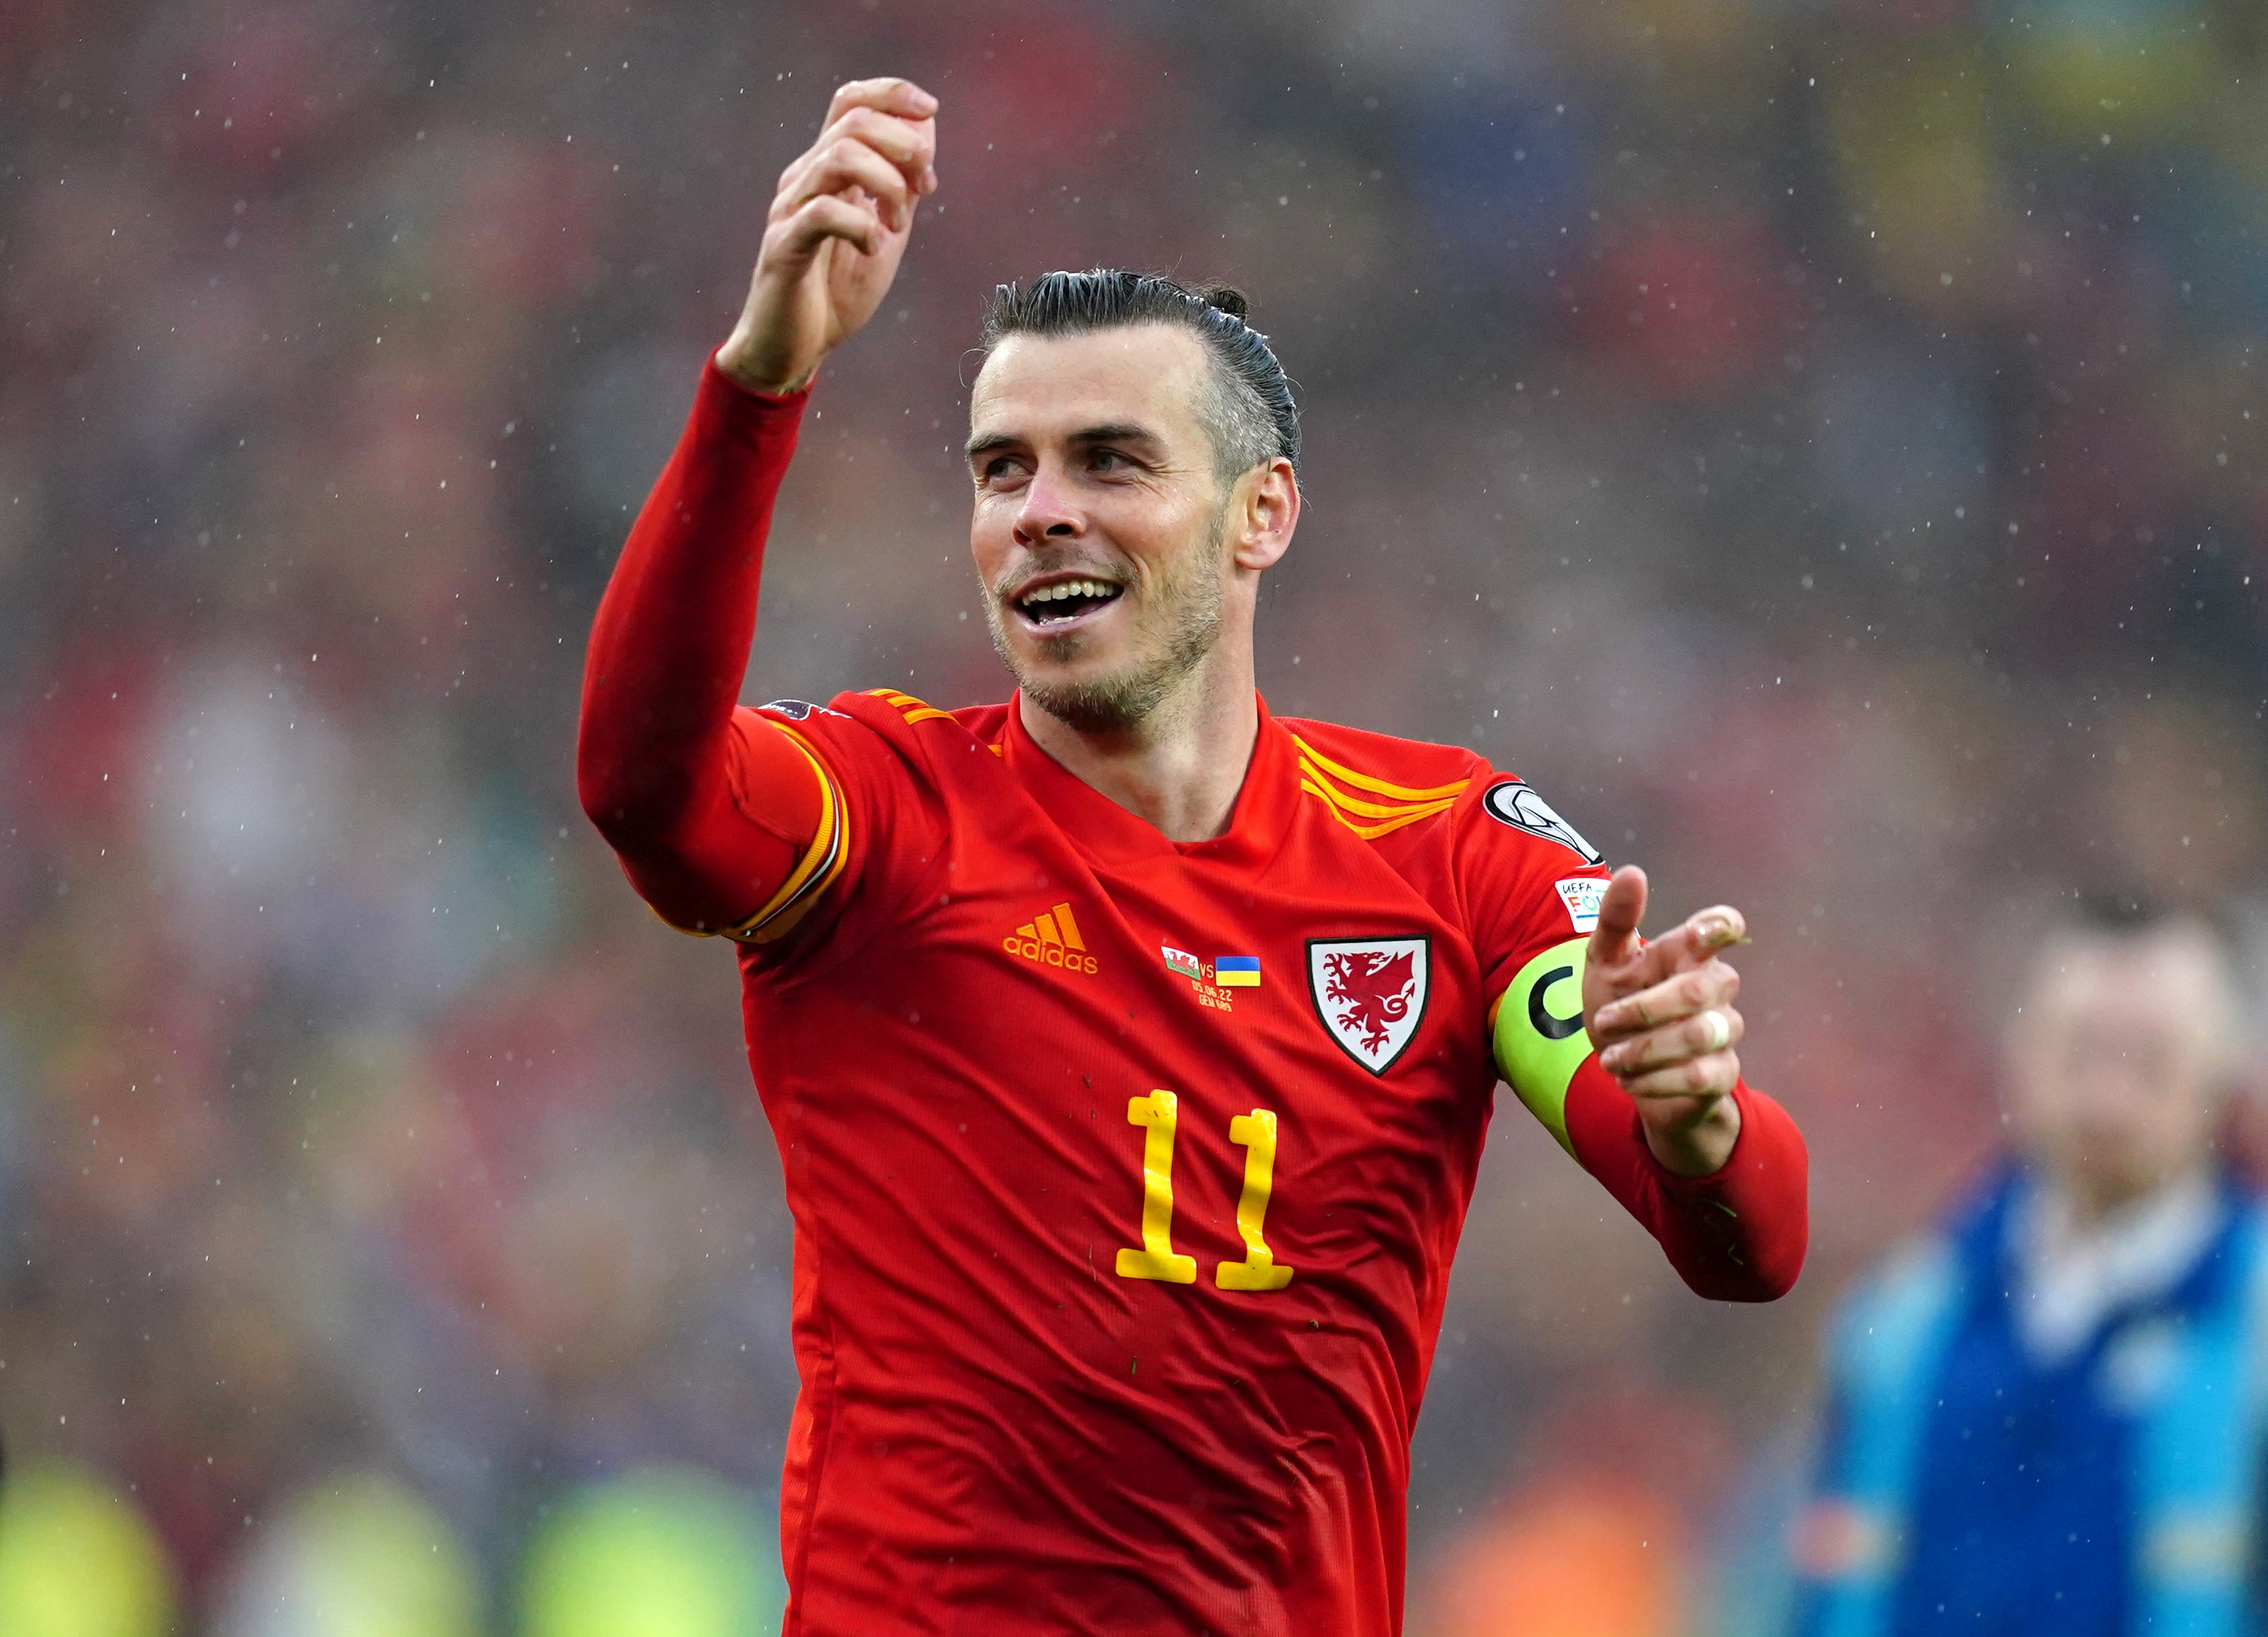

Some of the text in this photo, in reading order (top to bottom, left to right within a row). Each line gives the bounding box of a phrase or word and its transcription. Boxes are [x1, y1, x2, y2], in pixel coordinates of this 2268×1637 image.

[1562, 882, 1592, 894] UEFA
[1002, 937, 1098, 974] adidas
[1200, 963, 1213, 978] VS
[1191, 980, 1232, 1001] 05.06.22
[1528, 966, 1584, 1039] C
[1116, 1089, 1294, 1291] 11
